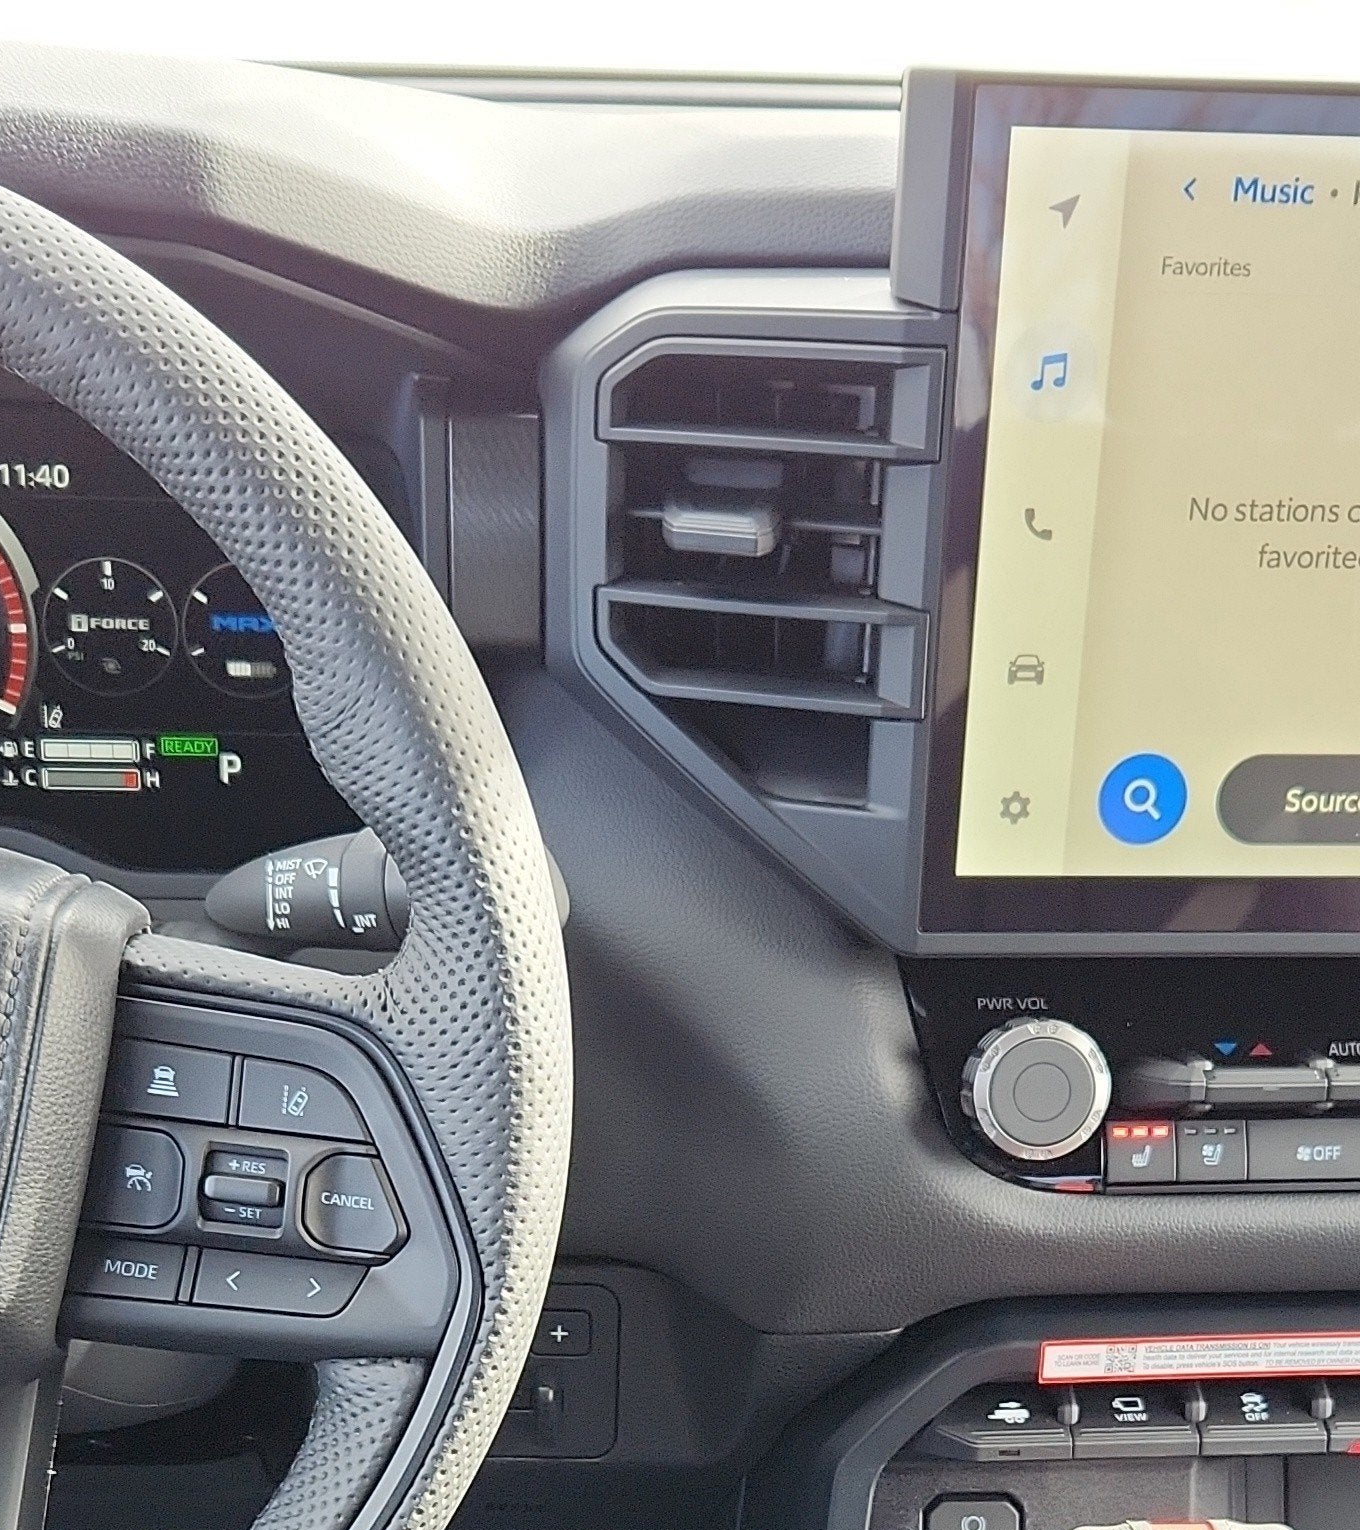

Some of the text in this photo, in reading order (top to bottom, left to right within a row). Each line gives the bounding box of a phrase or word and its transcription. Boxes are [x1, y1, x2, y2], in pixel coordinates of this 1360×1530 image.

[1232, 175, 1315, 206] Music
[1160, 255, 1252, 279] Favorites
[1188, 497, 1229, 522] No
[1234, 496, 1340, 523] stations
[101, 578, 115, 591] 10
[66, 637, 75, 650] 0
[141, 638, 157, 652] 20
[24, 741, 35, 759] E
[144, 742, 156, 759] F
[163, 740, 217, 753] READY
[218, 752, 242, 785] P
[24, 769, 37, 787] C
[146, 771, 161, 788] H
[274, 858, 303, 871] MIST
[274, 873, 296, 885] OFF
[274, 886, 294, 899] INT
[274, 902, 291, 914] LO
[276, 917, 290, 929] HI
[353, 914, 378, 928] INT
[976, 997, 1048, 1011] PWR VOL
[1311, 1146, 1342, 1162] OFF
[321, 1191, 375, 1212] CANCEL
[104, 1258, 159, 1280] MODE
[1113, 1410, 1148, 1423] VIEW
[1243, 1411, 1270, 1423] OFF
